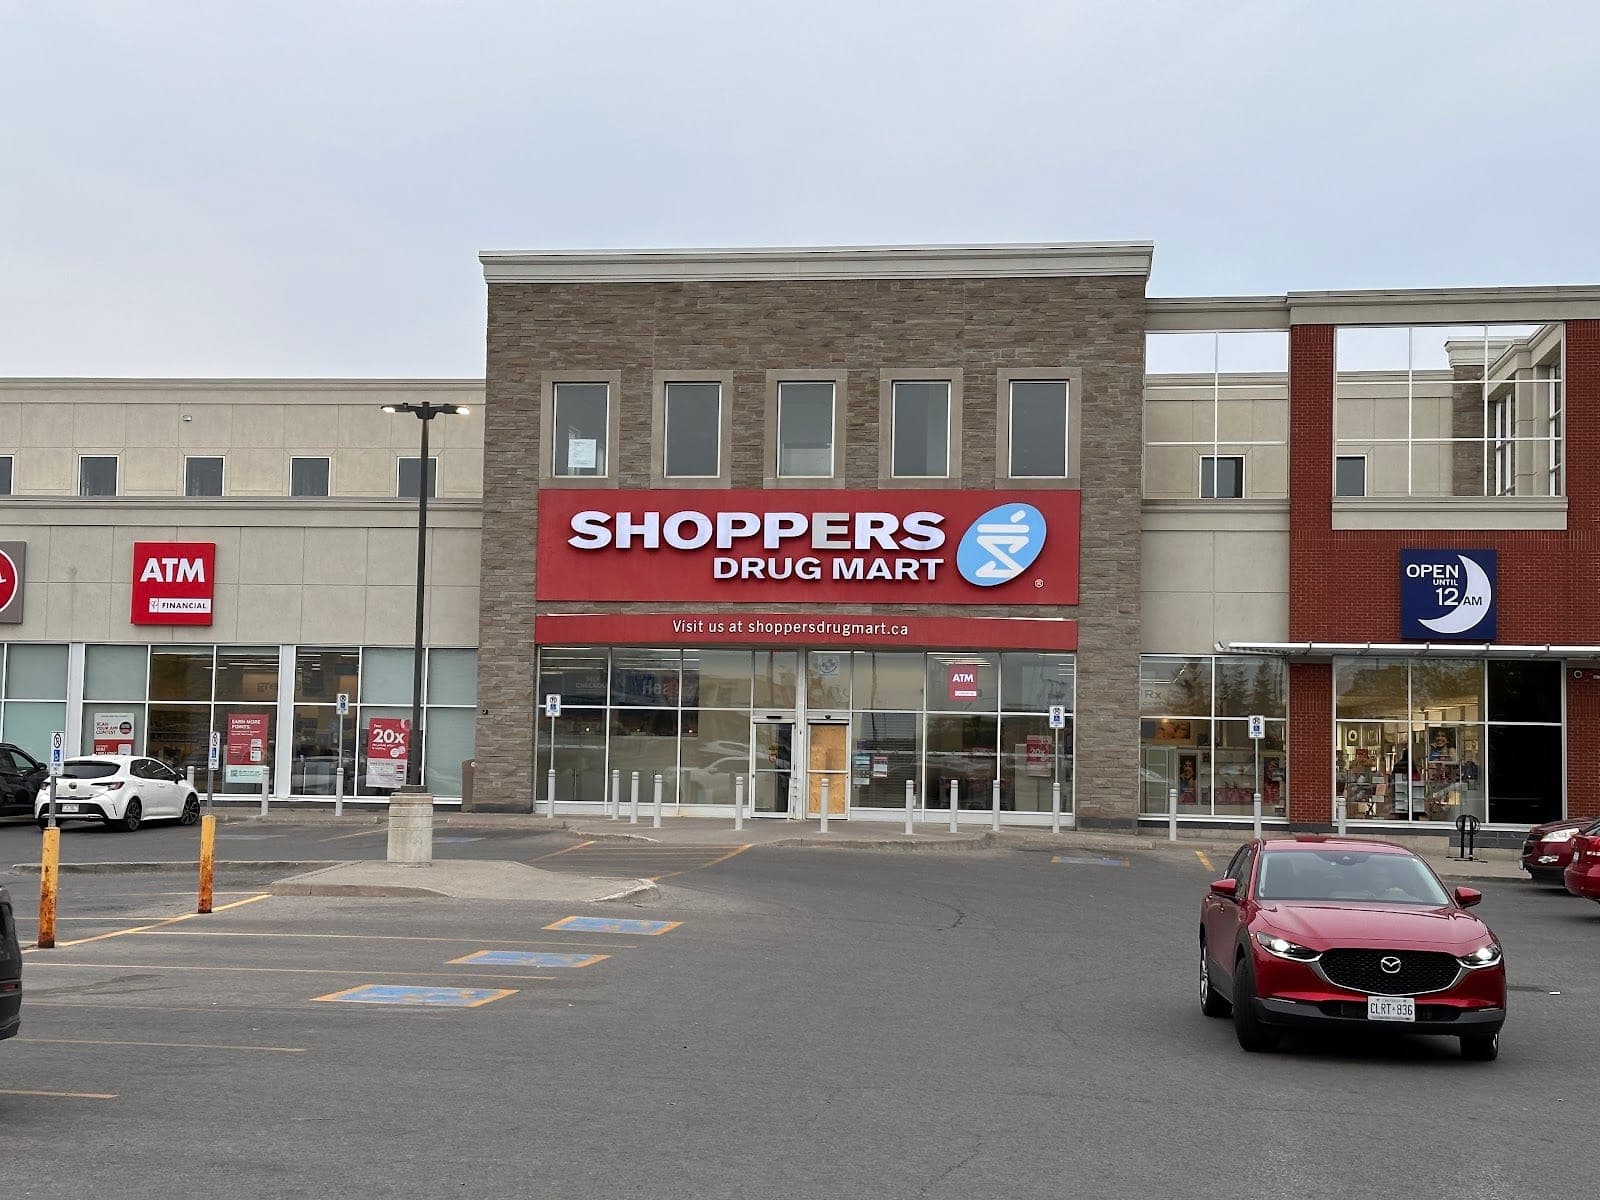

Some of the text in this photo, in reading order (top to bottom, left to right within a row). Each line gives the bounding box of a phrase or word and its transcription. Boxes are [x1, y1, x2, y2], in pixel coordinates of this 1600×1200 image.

[567, 510, 946, 551] SHOPPERS
[139, 557, 206, 583] ATM
[713, 556, 945, 581] DRUG MART
[1406, 564, 1459, 578] OPEN
[1435, 587, 1483, 606] 12 AM
[672, 619, 909, 636] Visit us at shoppersdrugmart.ca
[952, 673, 974, 683] ATM
[372, 728, 405, 743] 20x
